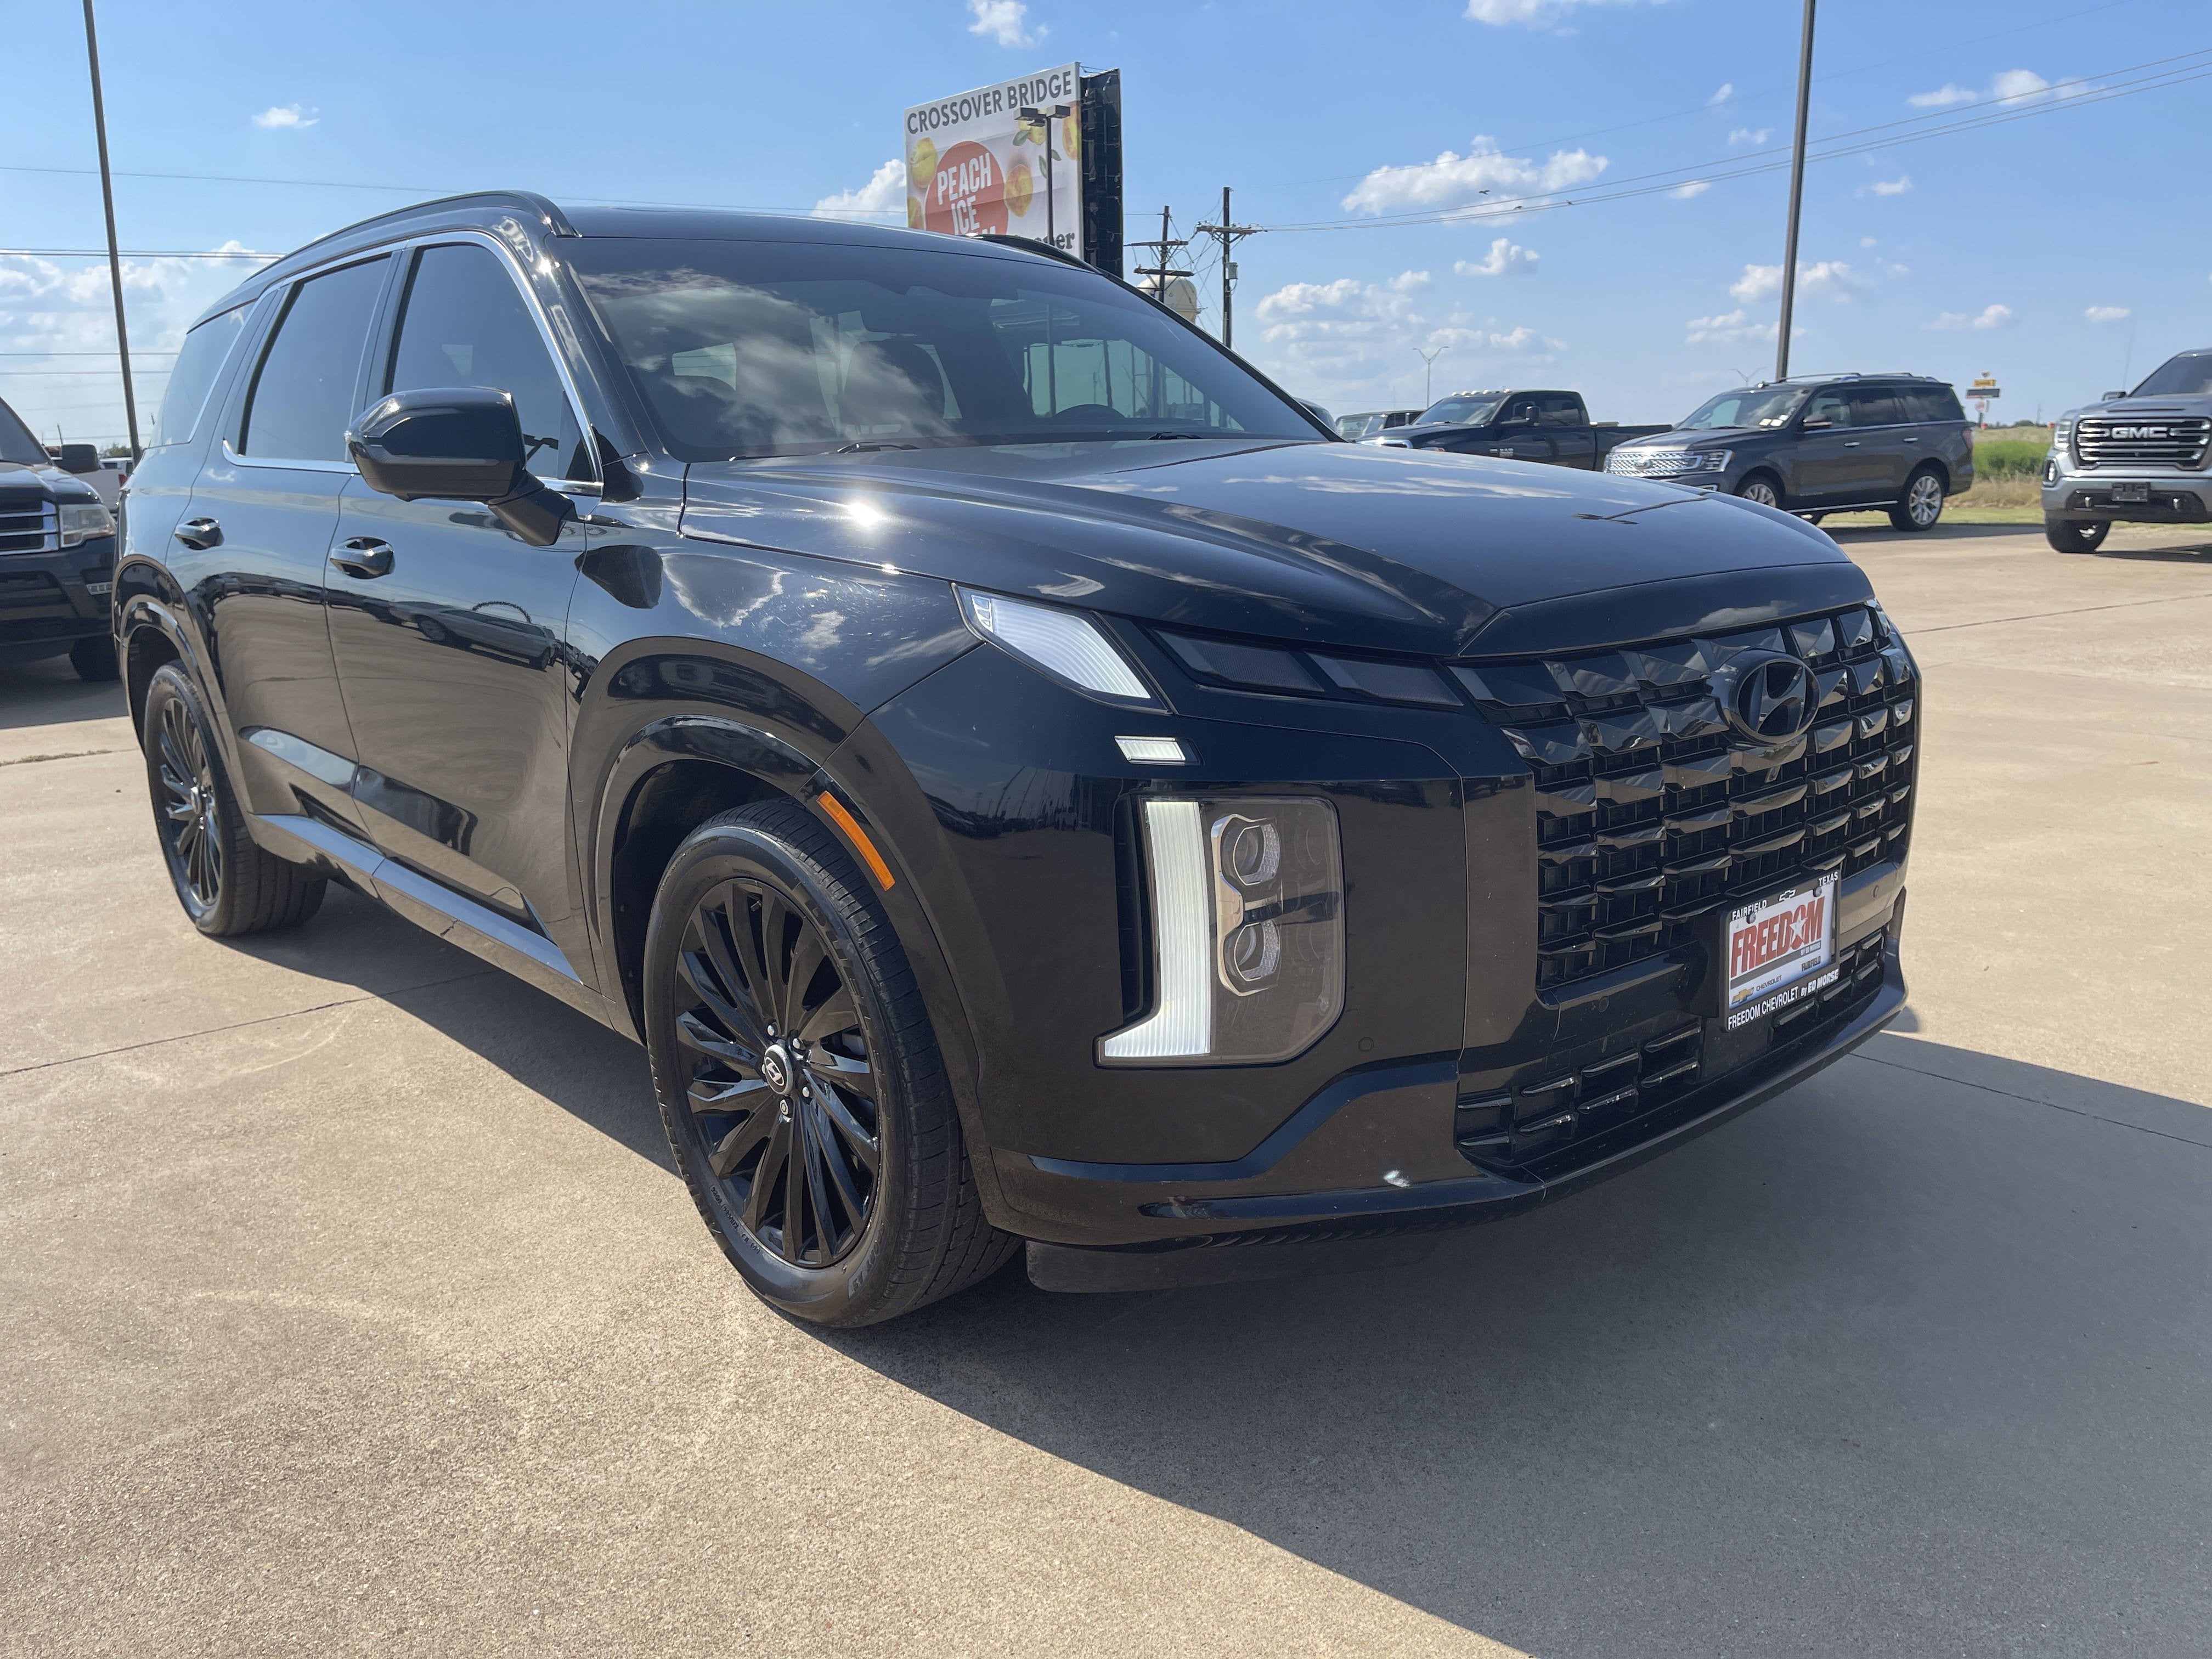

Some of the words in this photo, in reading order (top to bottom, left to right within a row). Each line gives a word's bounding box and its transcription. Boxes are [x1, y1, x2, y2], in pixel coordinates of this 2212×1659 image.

[907, 89, 1002, 134] CROSSOVER
[1007, 71, 1072, 109] BRIDGE
[937, 153, 991, 205] PEACH
[951, 195, 980, 234] ICE
[2112, 426, 2169, 439] GMC
[1732, 899, 1767, 921] FAIRFIELD
[1818, 871, 1838, 887] TEXAS
[1730, 895, 1825, 978] FREEDOM
[1728, 1003, 1760, 1030] FREEDOM
[1762, 986, 1799, 1014] CHEVROLET
[1808, 980, 1816, 994] ED
[1816, 969, 1839, 989] MORSE
[1756, 975, 1782, 992] CHEVROLET
